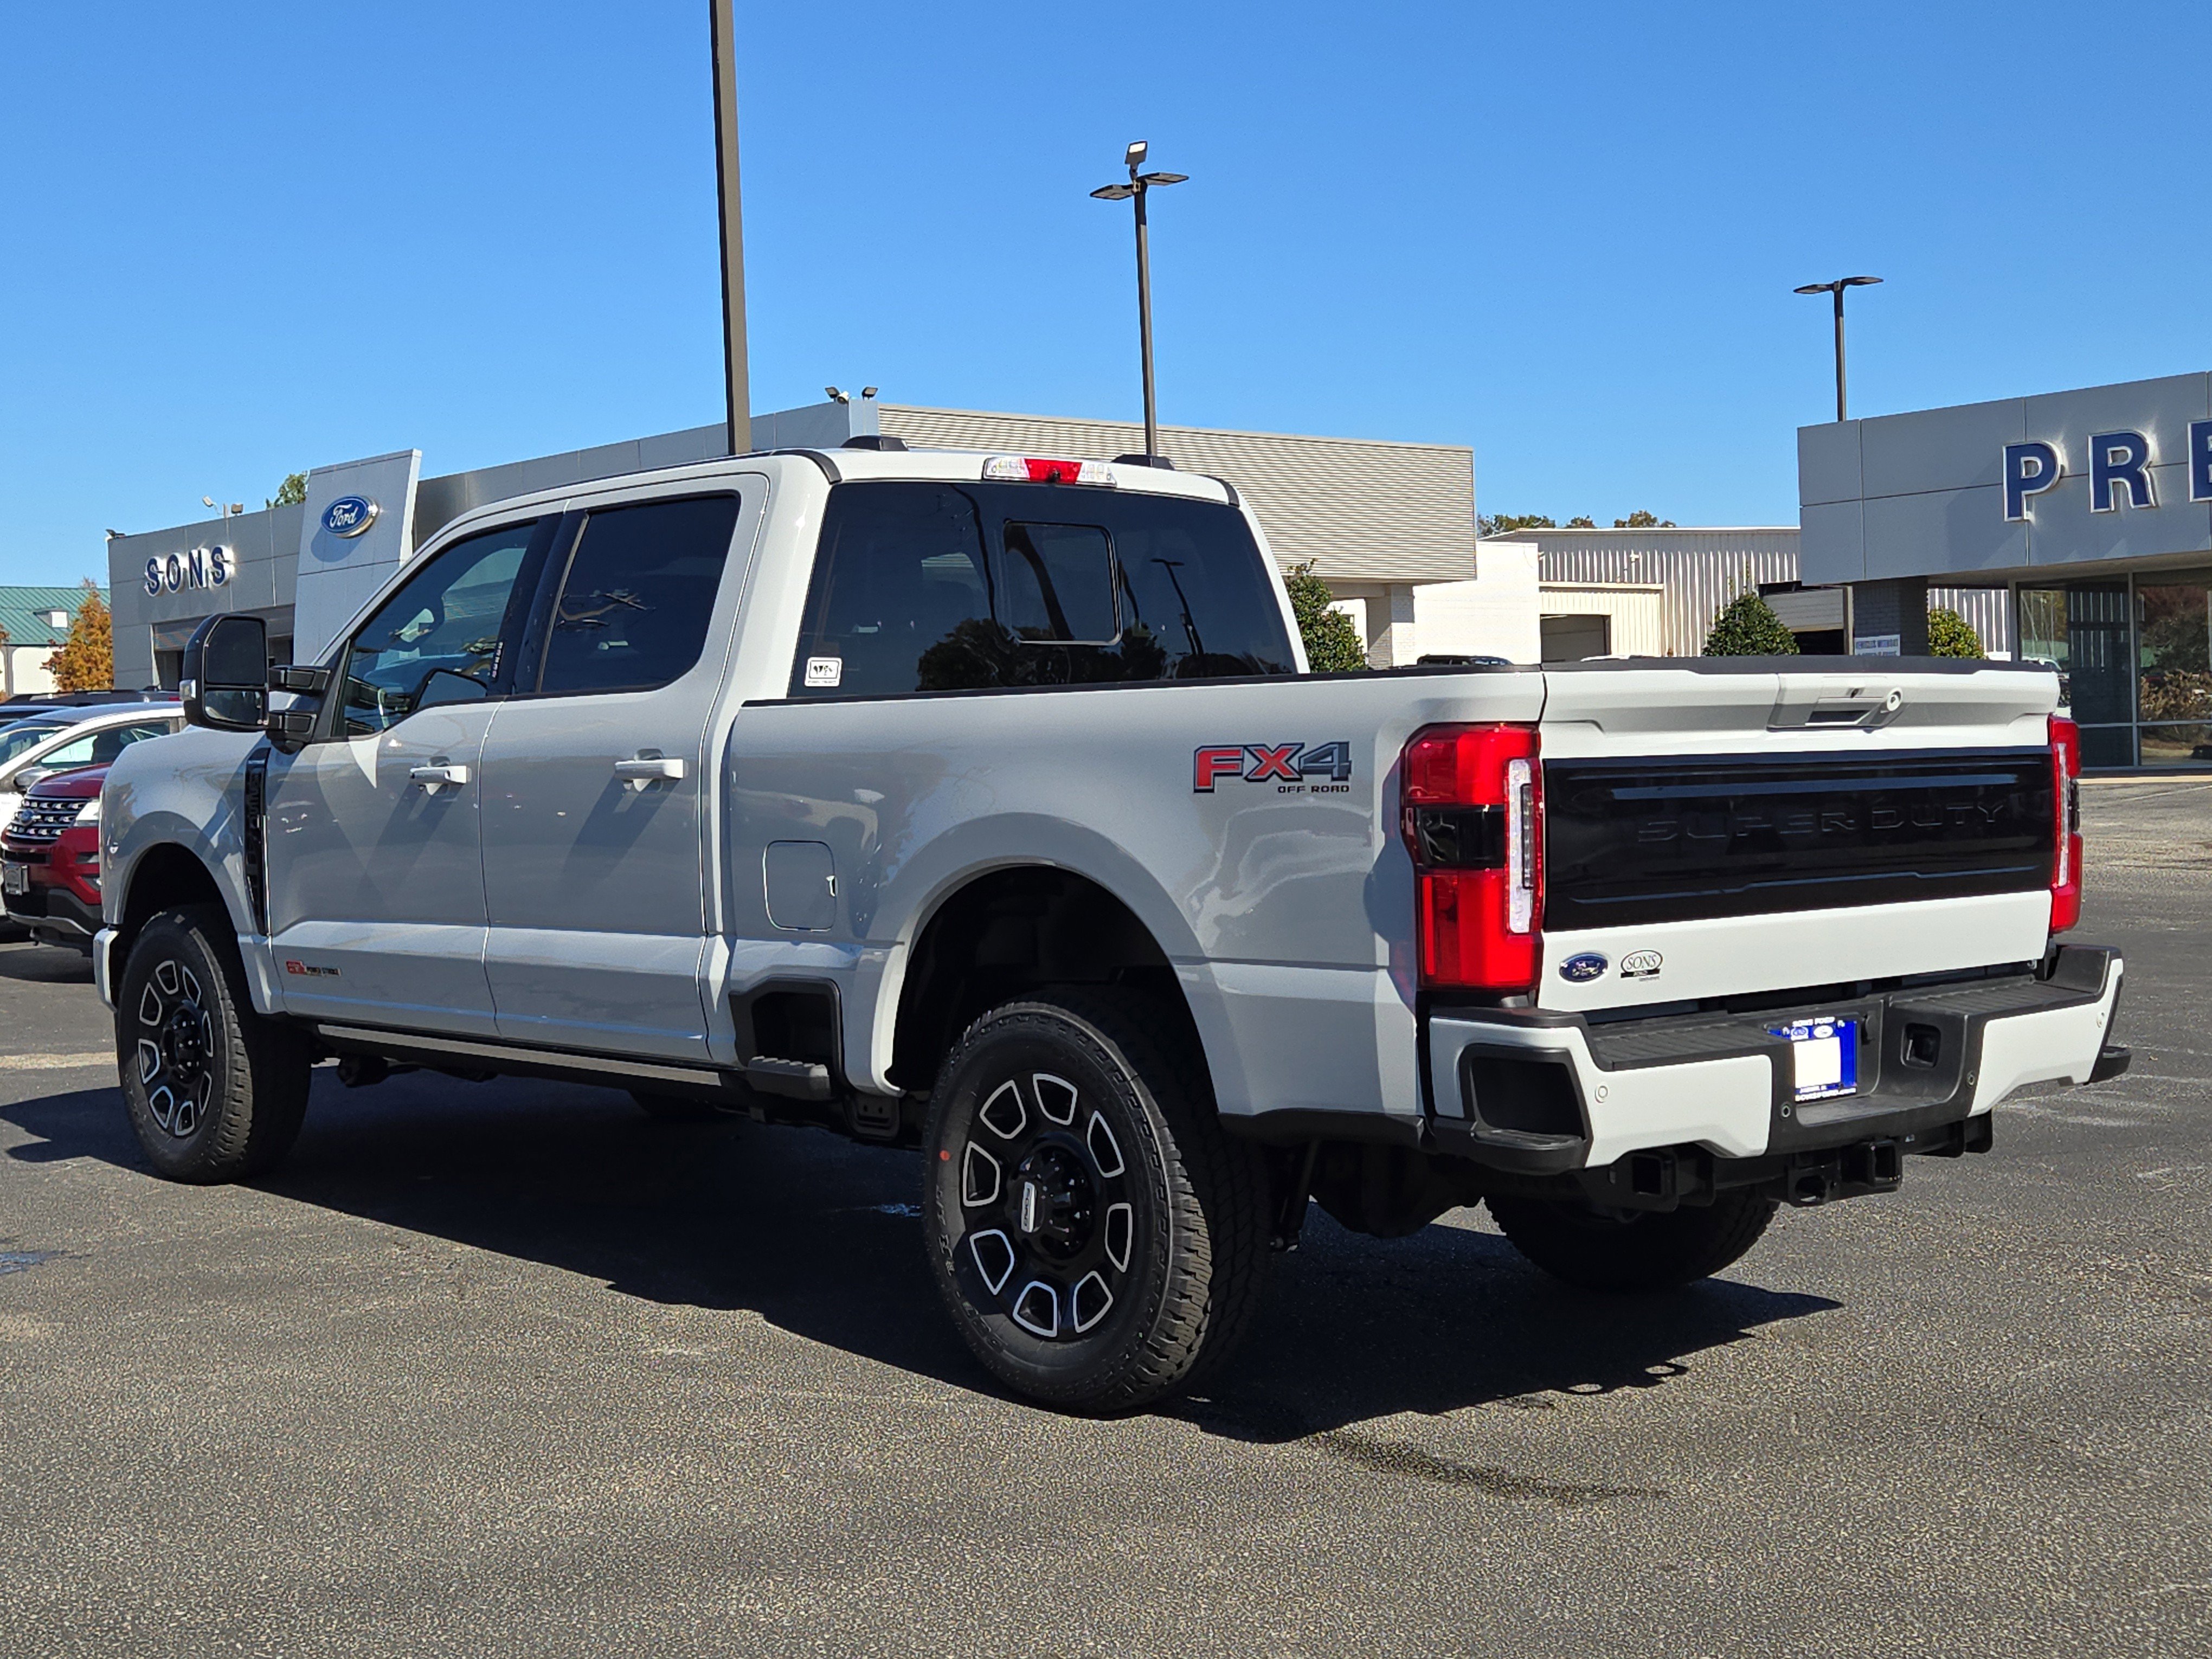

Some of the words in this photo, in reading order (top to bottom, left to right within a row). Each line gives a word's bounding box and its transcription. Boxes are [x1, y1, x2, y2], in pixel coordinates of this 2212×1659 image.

[329, 503, 358, 528] Ford
[144, 545, 231, 597] SONS
[1193, 741, 1352, 793] FX4
[1310, 785, 1349, 793] ROAD
[1637, 810, 1858, 843] SUPER
[1870, 799, 2006, 831] DUTY
[1626, 954, 1657, 970] SONS
